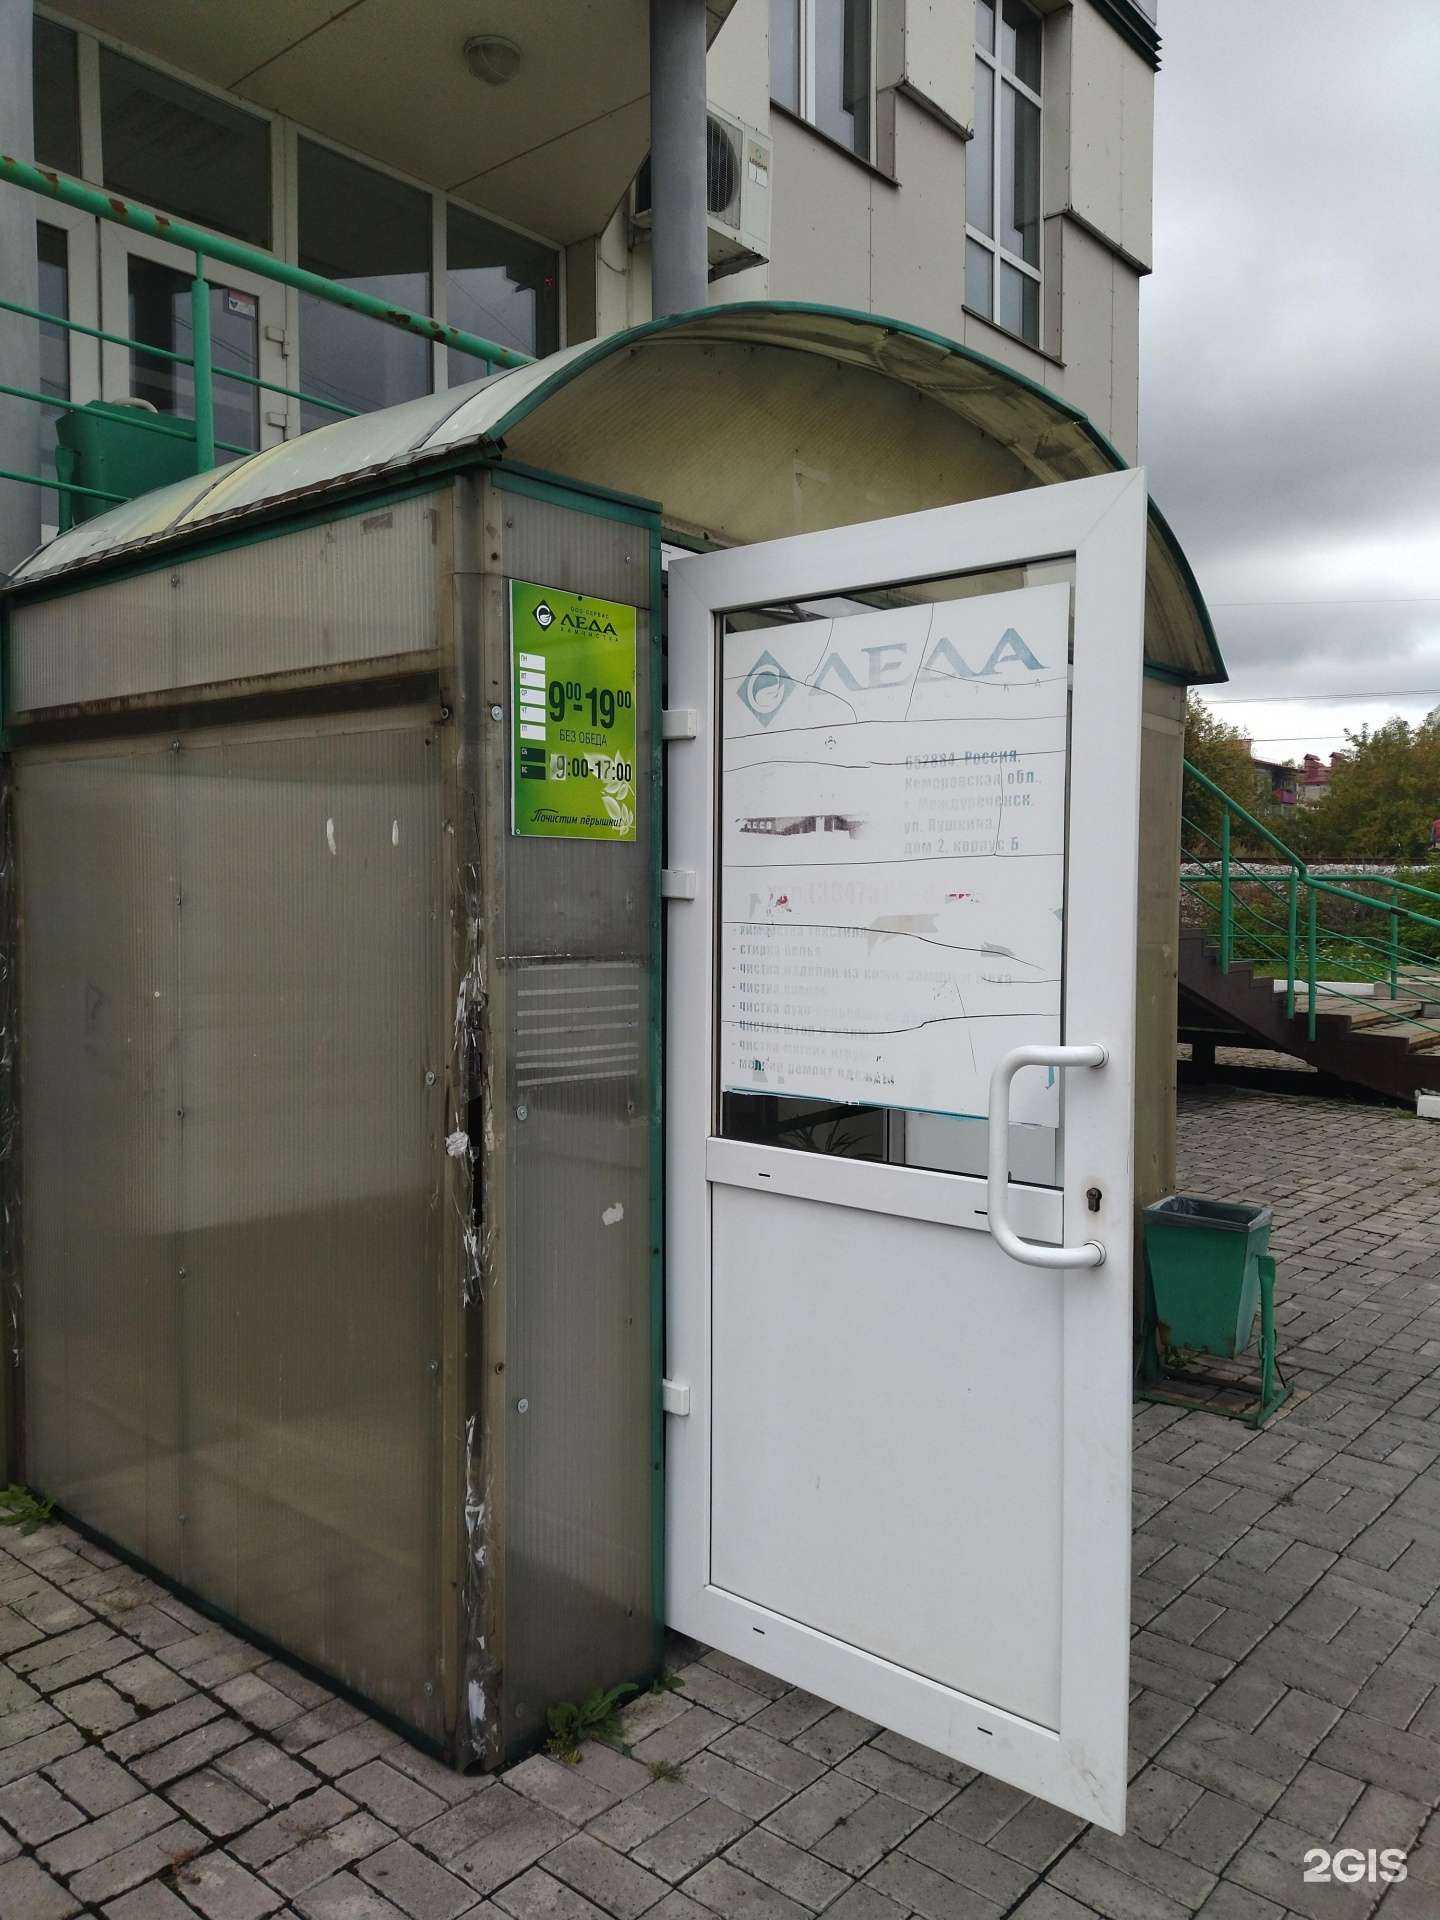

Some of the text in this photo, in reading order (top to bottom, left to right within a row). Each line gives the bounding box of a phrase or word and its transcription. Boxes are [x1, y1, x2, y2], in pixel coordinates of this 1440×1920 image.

[561, 613, 618, 636] ЛЕДА
[559, 729, 608, 747] БЕЗ ОБЕДА
[530, 808, 578, 825] Почистим
